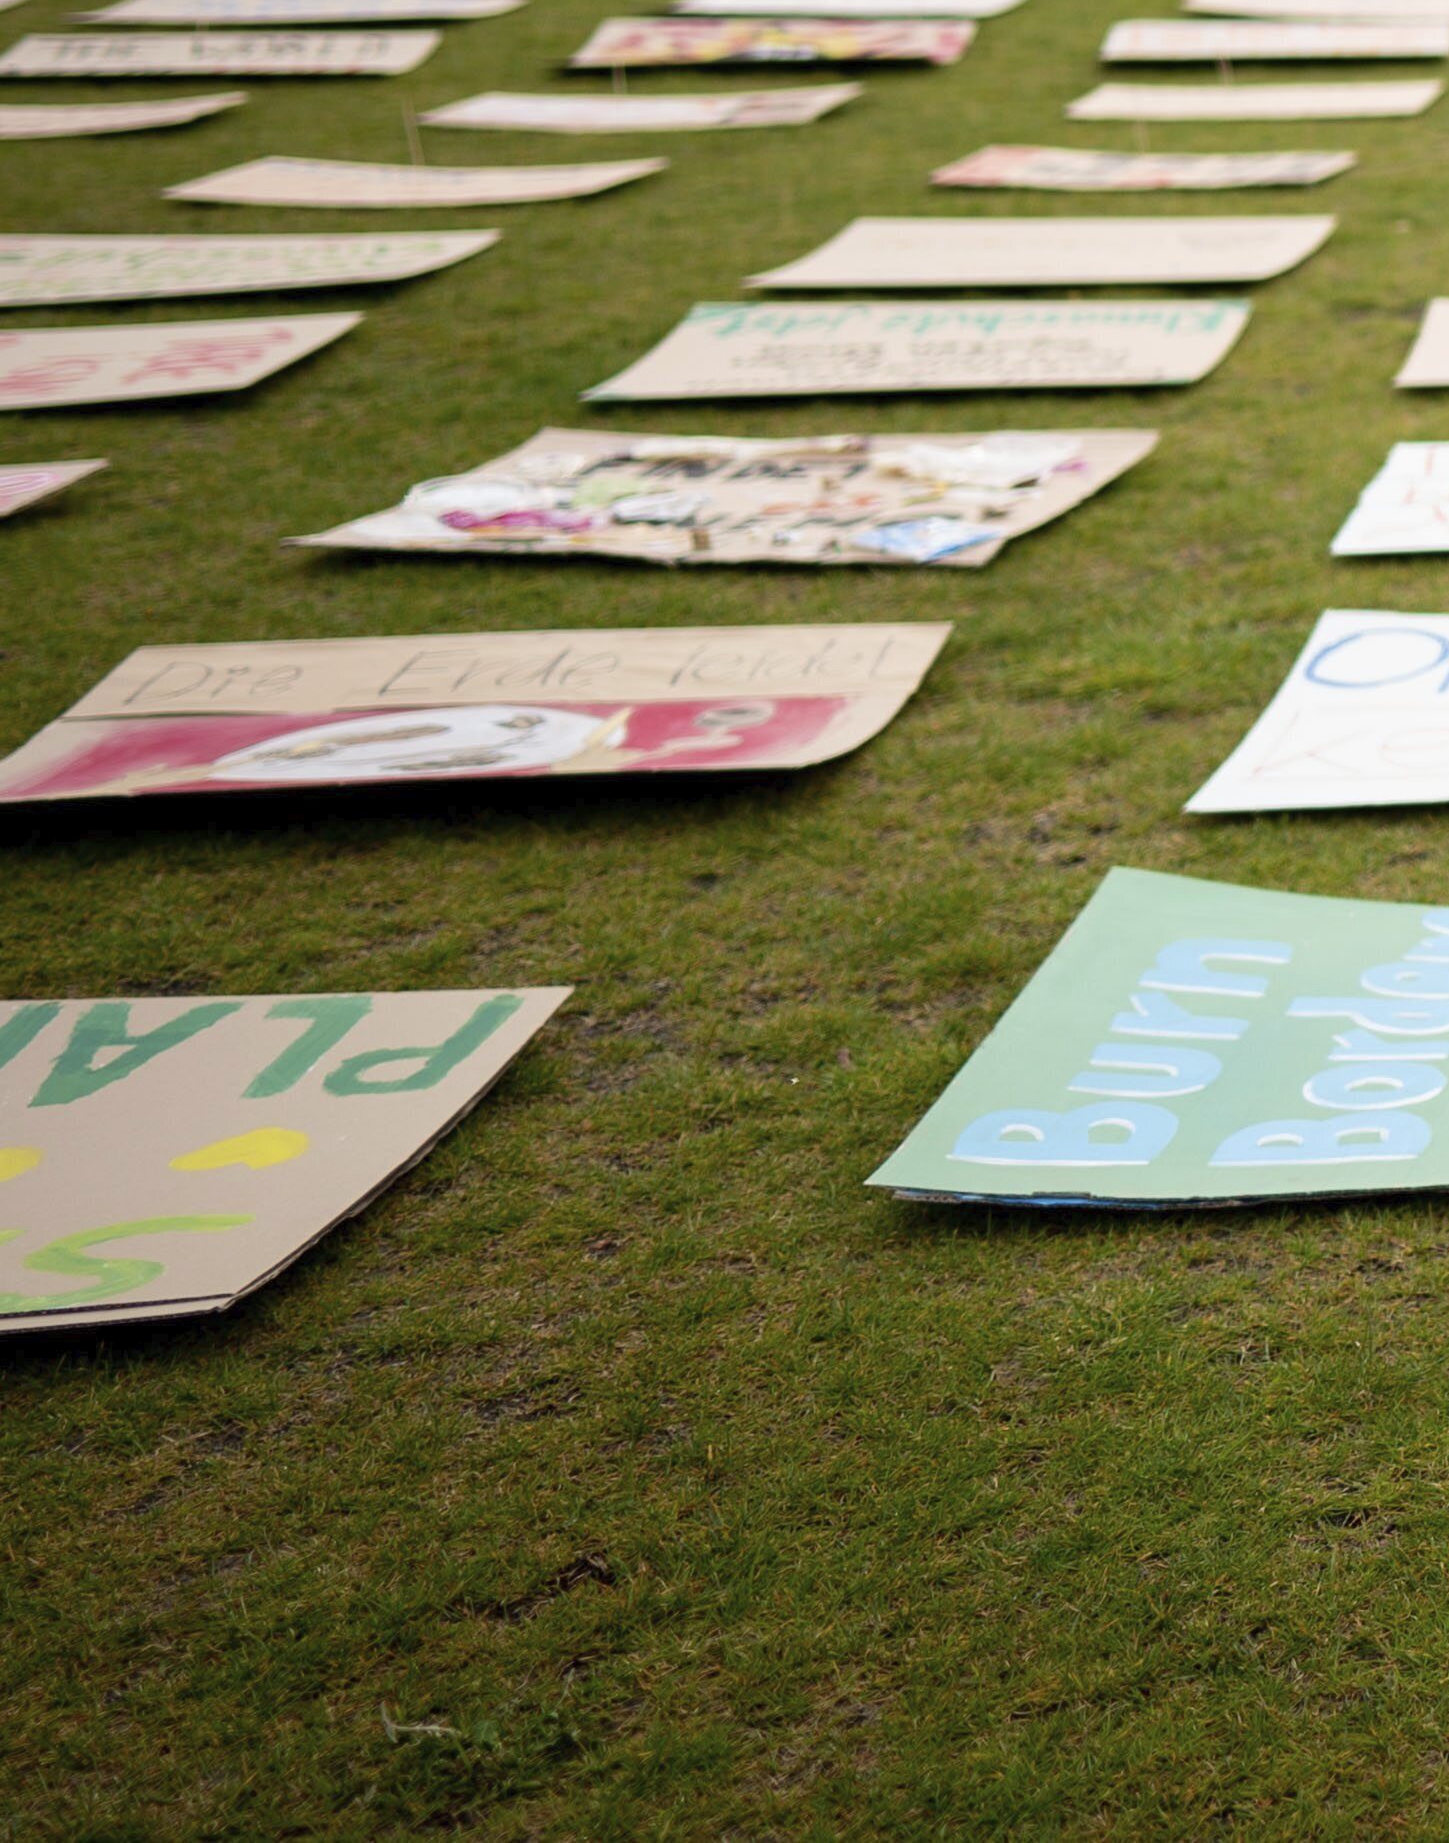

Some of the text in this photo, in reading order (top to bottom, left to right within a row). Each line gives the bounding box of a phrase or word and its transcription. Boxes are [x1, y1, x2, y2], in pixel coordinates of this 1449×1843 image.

[124, 659, 304, 705] Die
[377, 647, 621, 698] Erde
[946, 936, 1292, 1167] Burn
